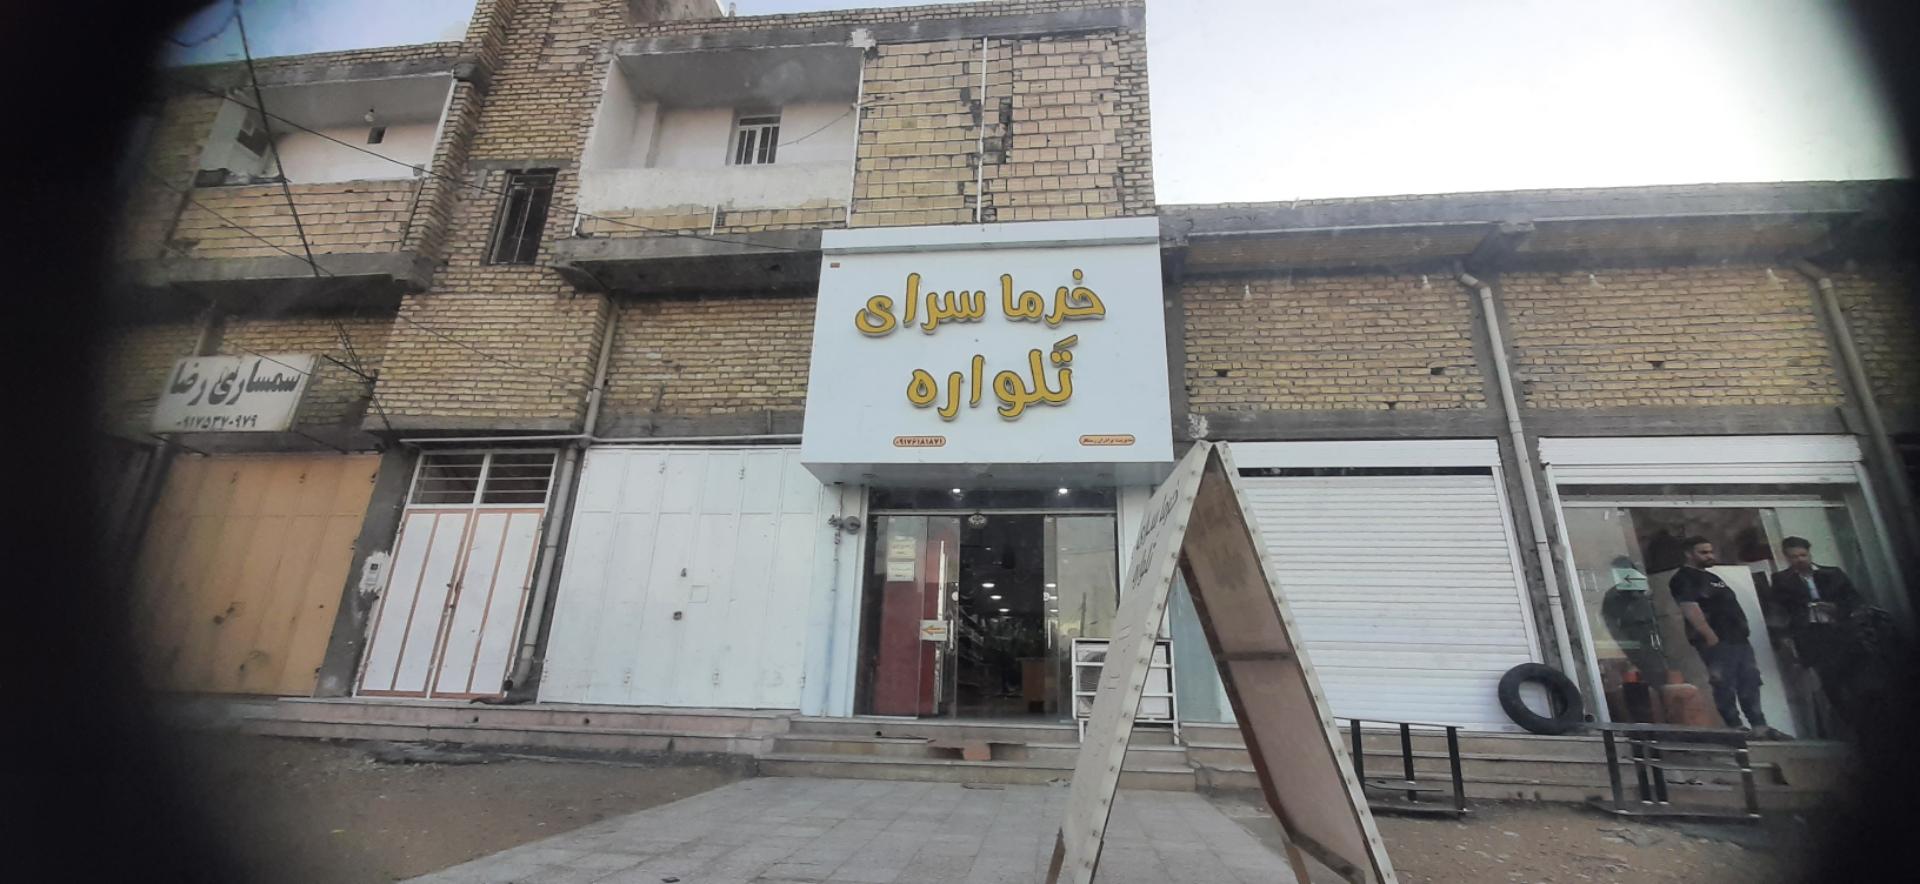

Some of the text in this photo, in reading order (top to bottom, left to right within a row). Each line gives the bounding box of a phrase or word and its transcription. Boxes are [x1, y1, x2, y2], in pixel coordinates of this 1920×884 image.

[855, 269, 1106, 336] خرما سرای
[170, 358, 301, 406] سمساری رضا
